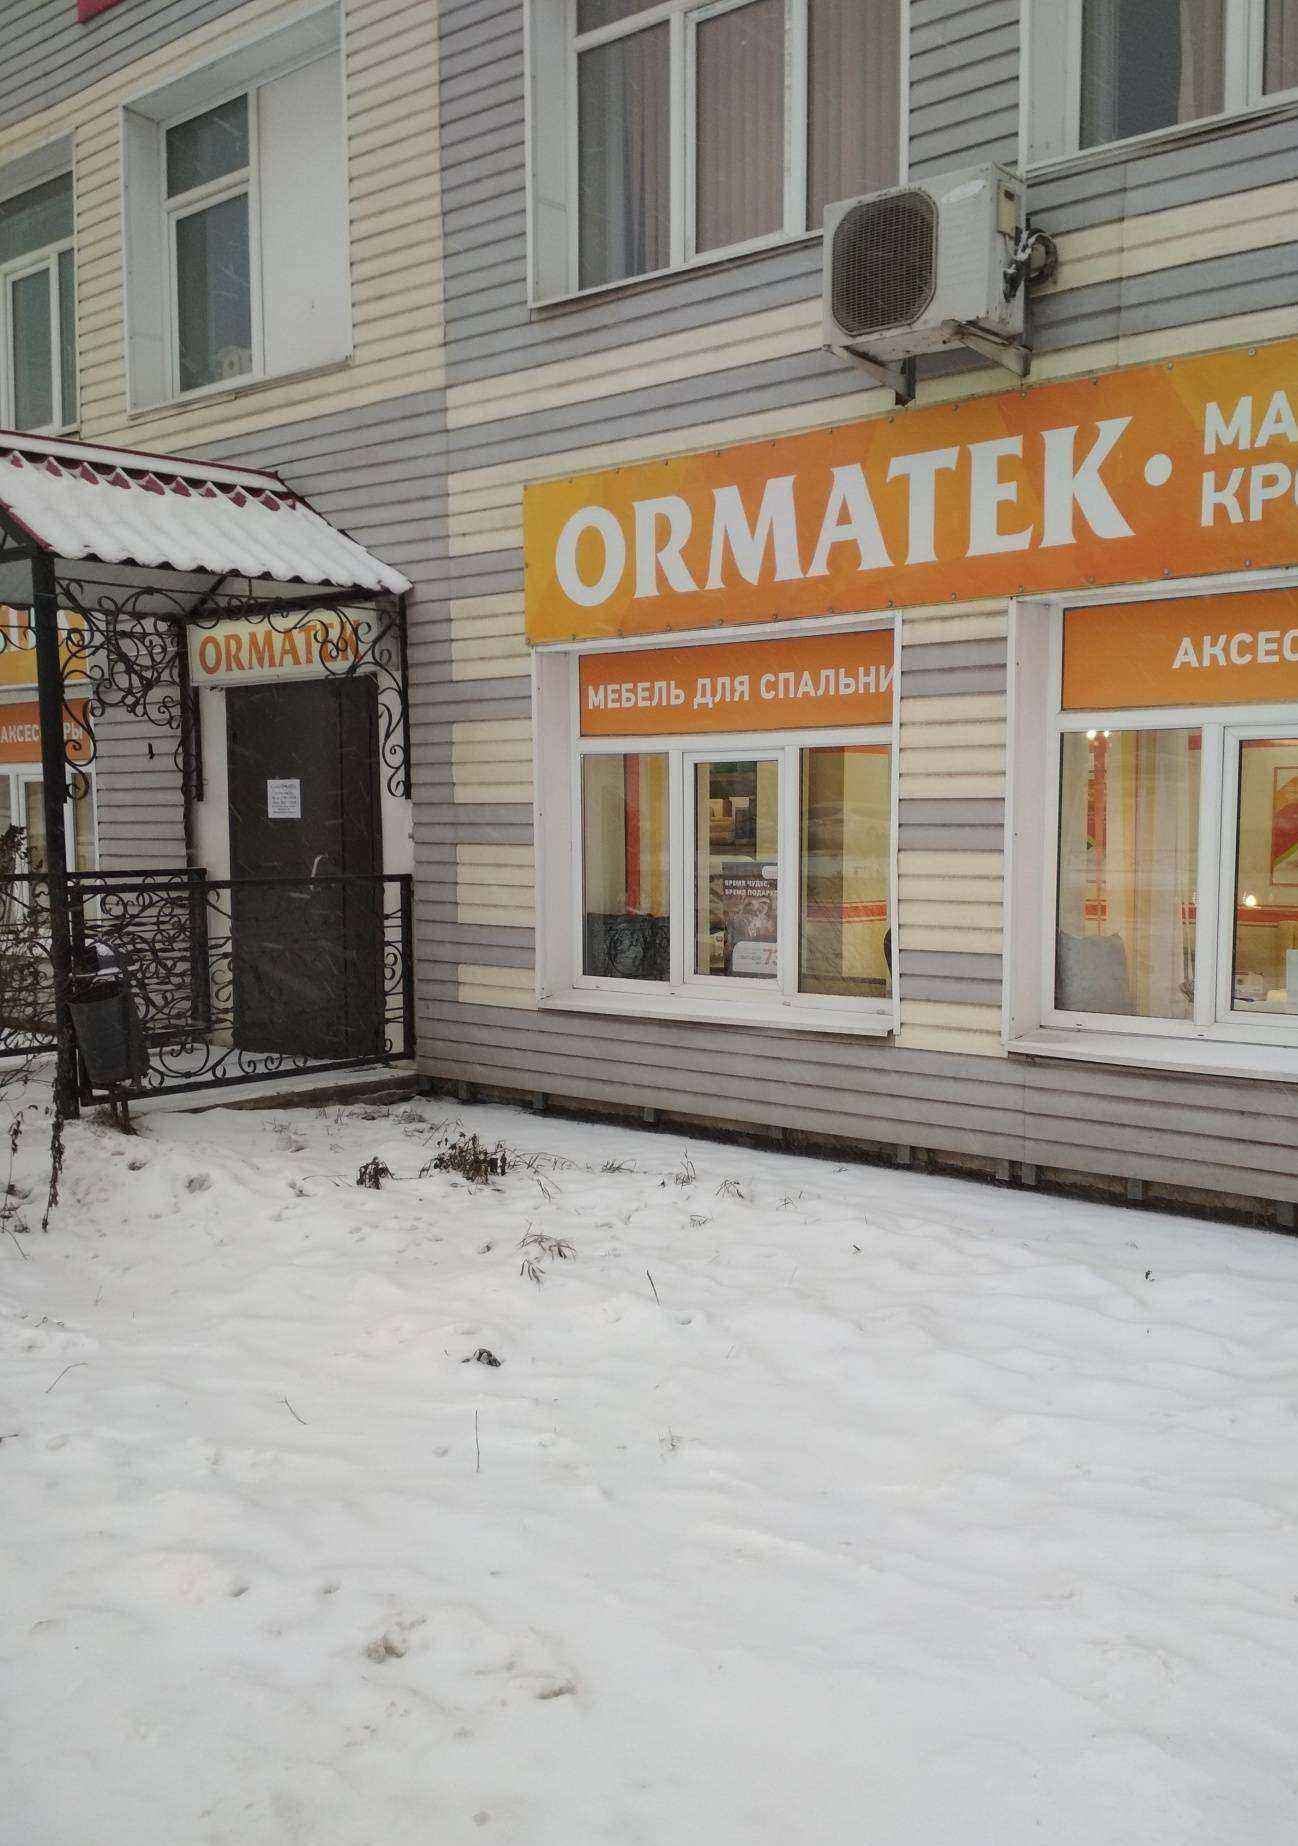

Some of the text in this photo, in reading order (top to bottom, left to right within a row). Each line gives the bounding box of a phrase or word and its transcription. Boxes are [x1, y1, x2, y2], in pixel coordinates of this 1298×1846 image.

[555, 415, 1136, 607] ORMATEK
[1200, 462, 1298, 528] КР
[588, 664, 895, 709] МЕБЕЛЬ ДЛЯ СПАЛЬНИ
